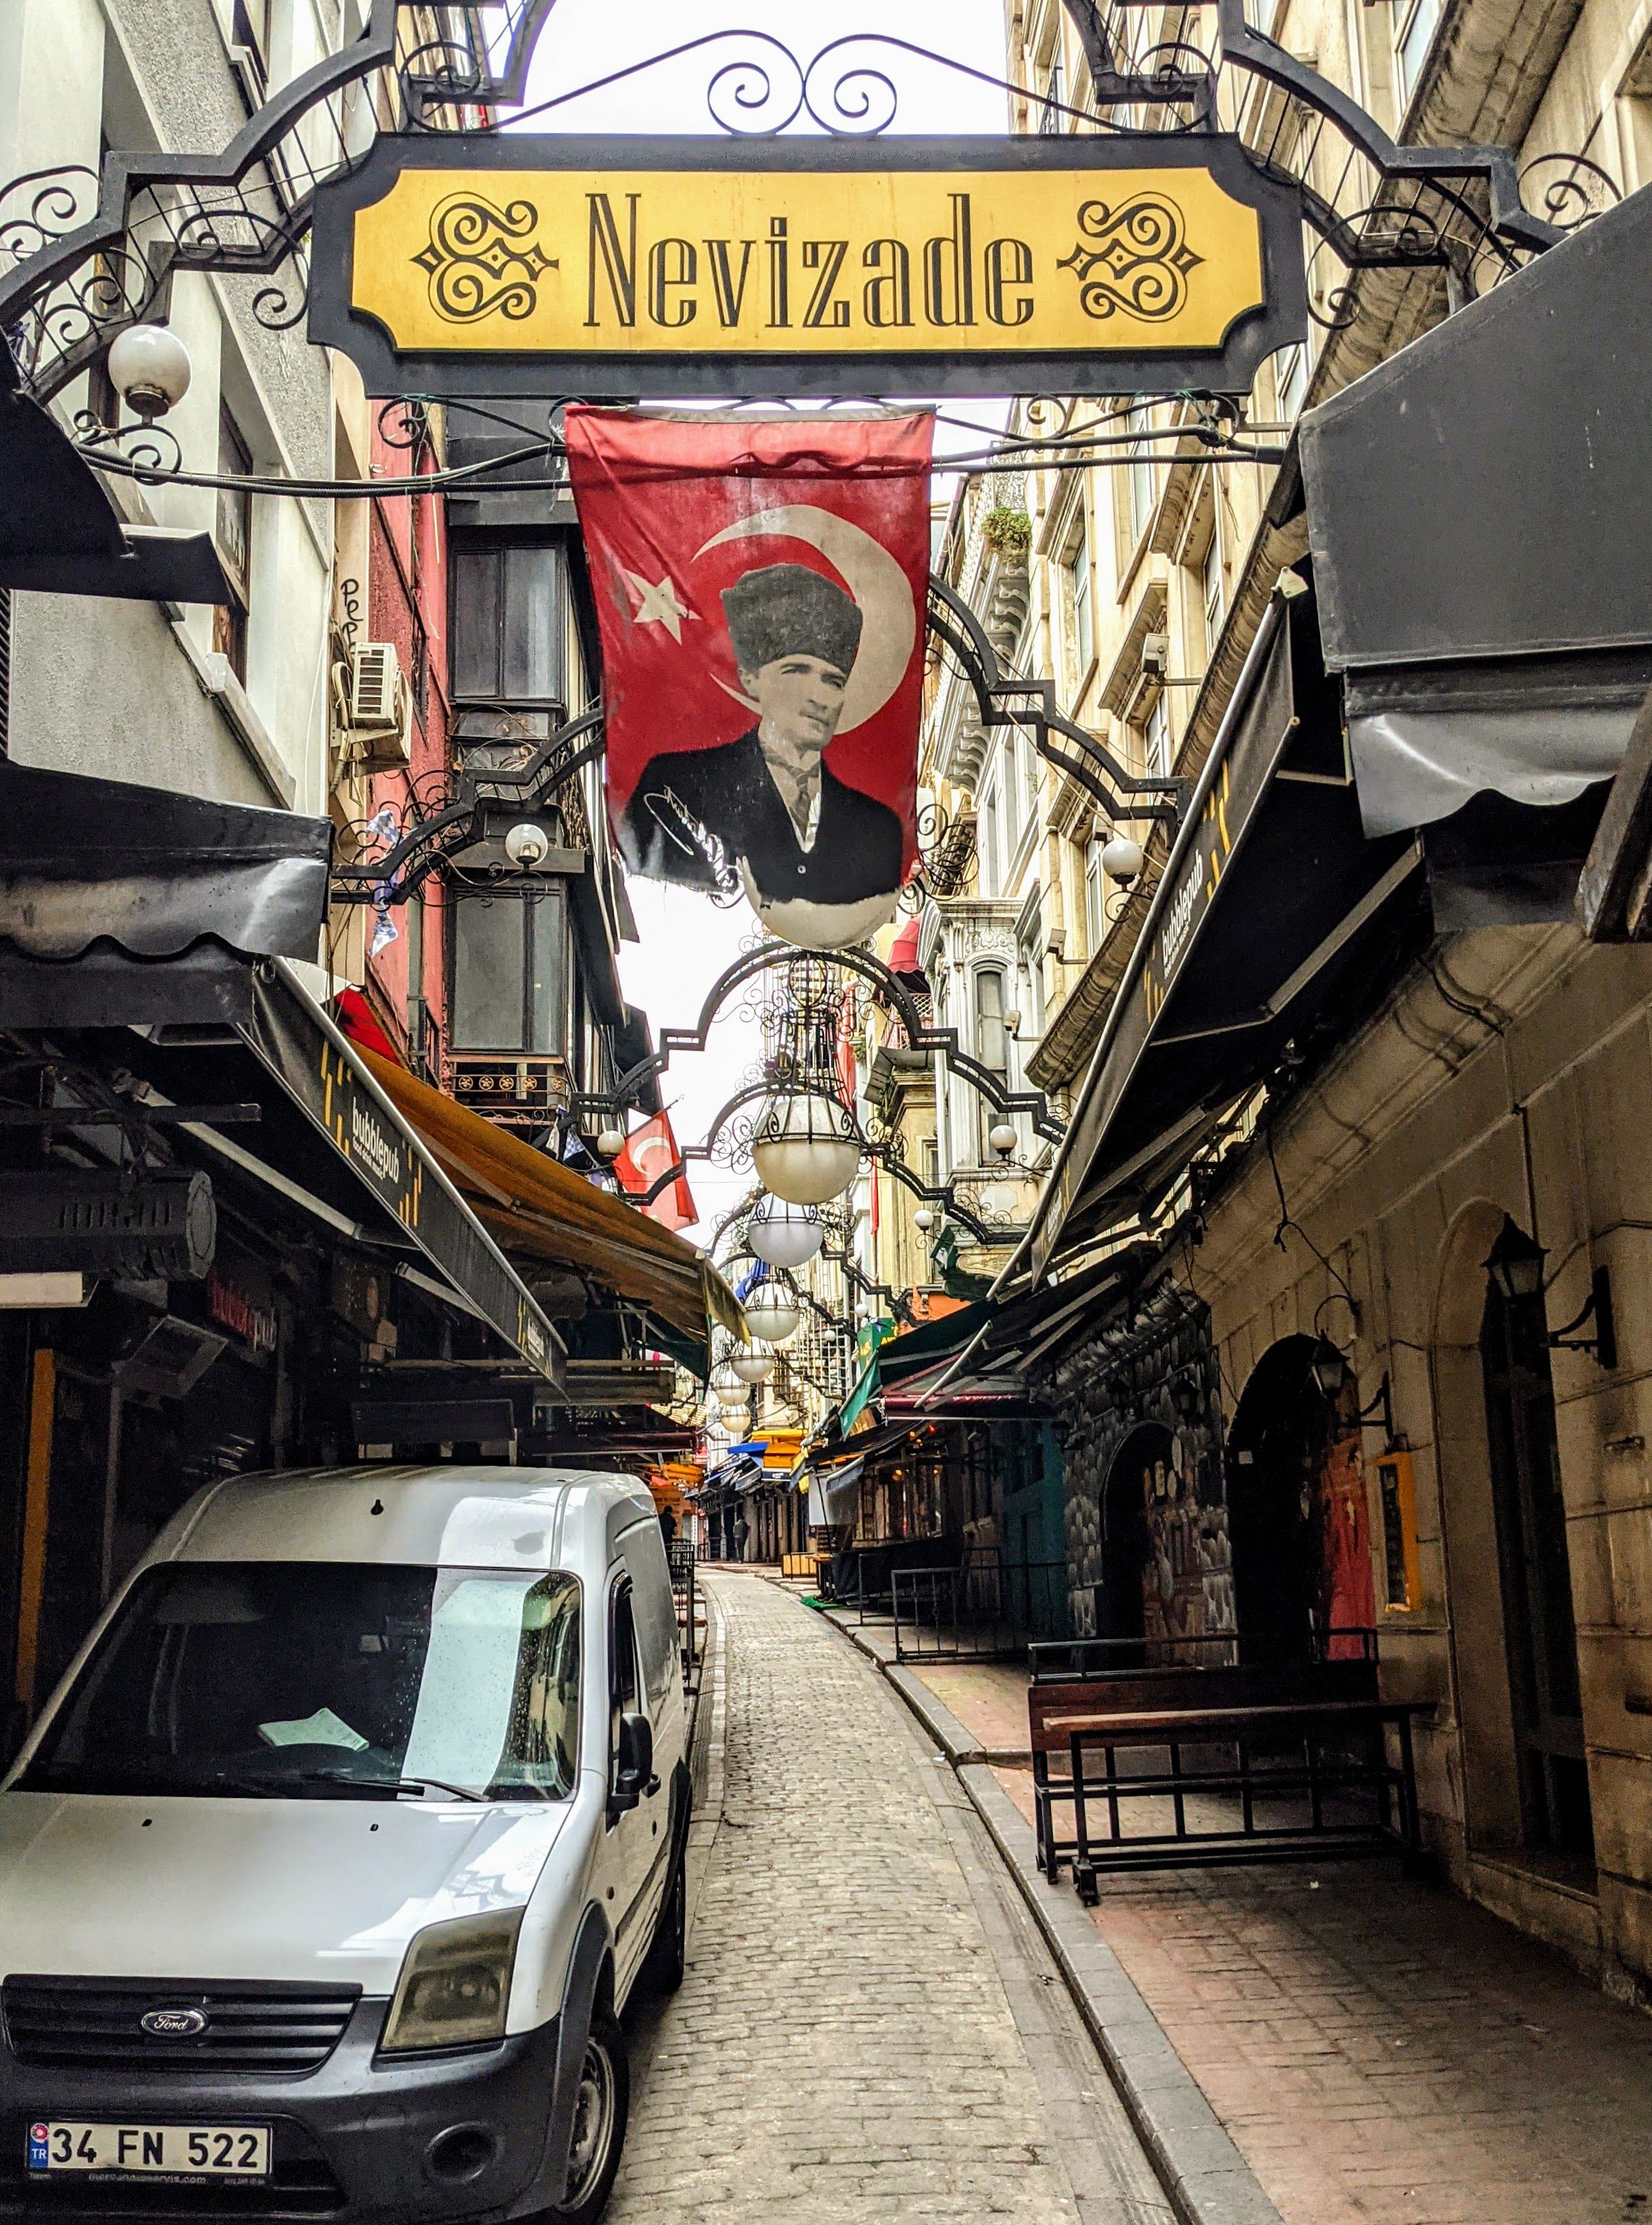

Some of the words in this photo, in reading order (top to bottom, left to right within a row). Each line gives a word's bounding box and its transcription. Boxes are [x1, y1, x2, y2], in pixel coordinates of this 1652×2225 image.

[583, 193, 1034, 328] Nevizade
[1162, 848, 1203, 967] bubblepub
[353, 1096, 399, 1184] bubblepub
[154, 2014, 189, 2030] Ford
[31, 2149, 47, 2159] TR
[52, 2128, 97, 2164] 34
[118, 2129, 163, 2165] FN
[188, 2132, 258, 2168] 522
